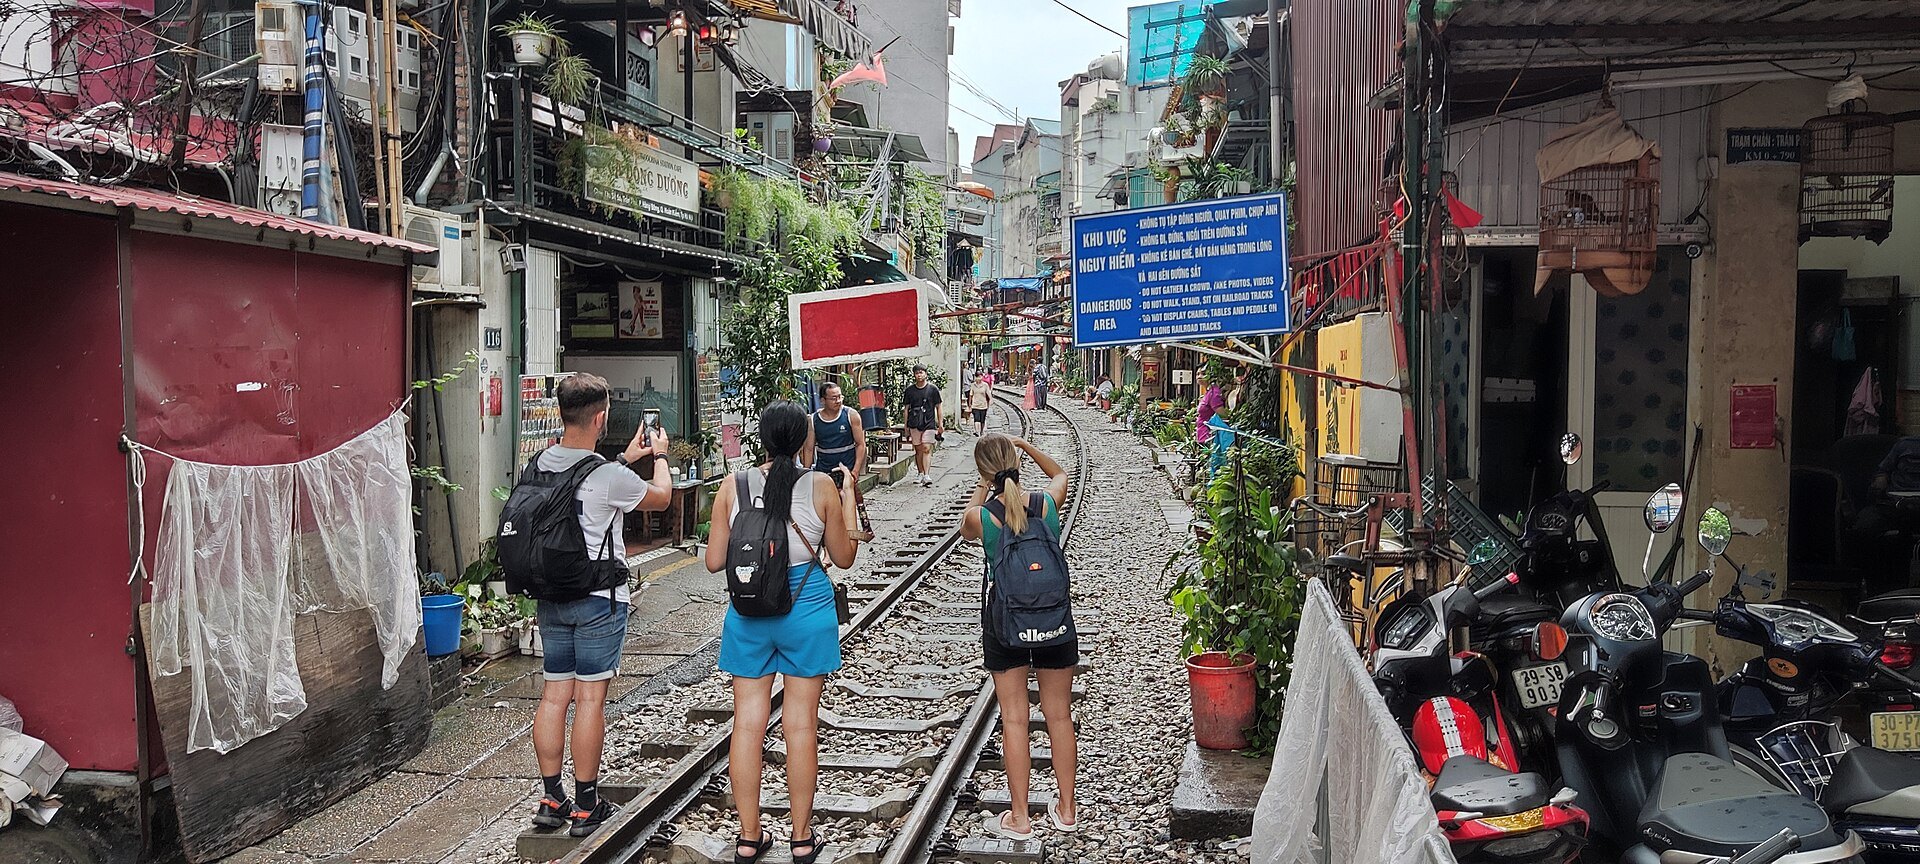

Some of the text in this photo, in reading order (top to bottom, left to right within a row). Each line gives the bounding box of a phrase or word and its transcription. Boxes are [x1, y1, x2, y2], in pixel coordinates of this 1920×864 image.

[1745, 151, 1761, 161] KM
[1764, 152, 1770, 160] 0
[1779, 151, 1795, 160] 790
[1140, 216, 1159, 230] KHÔNG
[1159, 216, 1166, 229] TỤ
[1214, 208, 1230, 222] QUAY
[1230, 207, 1248, 219] PHIM,
[1248, 205, 1265, 219] CHỤP
[1265, 200, 1278, 216] ẢNH
[1083, 228, 1127, 248] KHU VỰC
[1140, 233, 1159, 247] KHÔNG
[1200, 226, 1216, 240] TRÊN
[1216, 224, 1236, 239] ĐƯỜNG
[1079, 247, 1135, 273] NGUY HIỂM
[1140, 250, 1160, 264] KHÔNG
[1236, 241, 1256, 254] TRONG
[1147, 270, 1158, 282] HAI
[1170, 265, 1190, 280] ĐƯỜNG
[1142, 287, 1150, 296] DO
[1150, 286, 1162, 296] NOT
[1162, 284, 1184, 294] GATHER
[1184, 283, 1190, 293] A
[1189, 282, 1213, 292] CROWD,
[1227, 278, 1253, 289] PHOTOS,
[1252, 276, 1275, 287] VIDEOS
[1080, 298, 1132, 314] DANGEROUS
[1142, 290, 1274, 310] DO NOT WALK, STAND, SIT ON RAILROAD TRACKS
[1150, 312, 1163, 323] NOT
[1163, 311, 1187, 322] DISPLAY
[1187, 309, 1211, 320] CHAIRS,
[1210, 307, 1232, 318] TABLES
[1232, 306, 1245, 316] AND
[1245, 304, 1268, 315] PEDDLE
[1268, 303, 1278, 313] ON
[1093, 317, 1117, 331] AREA
[1140, 322, 1222, 337] AND ALONG RAILROAD TRACKS
[486, 331, 501, 346] 116
[1018, 625, 1068, 642] ellesse
[1879, 714, 1920, 731] 30-P7
